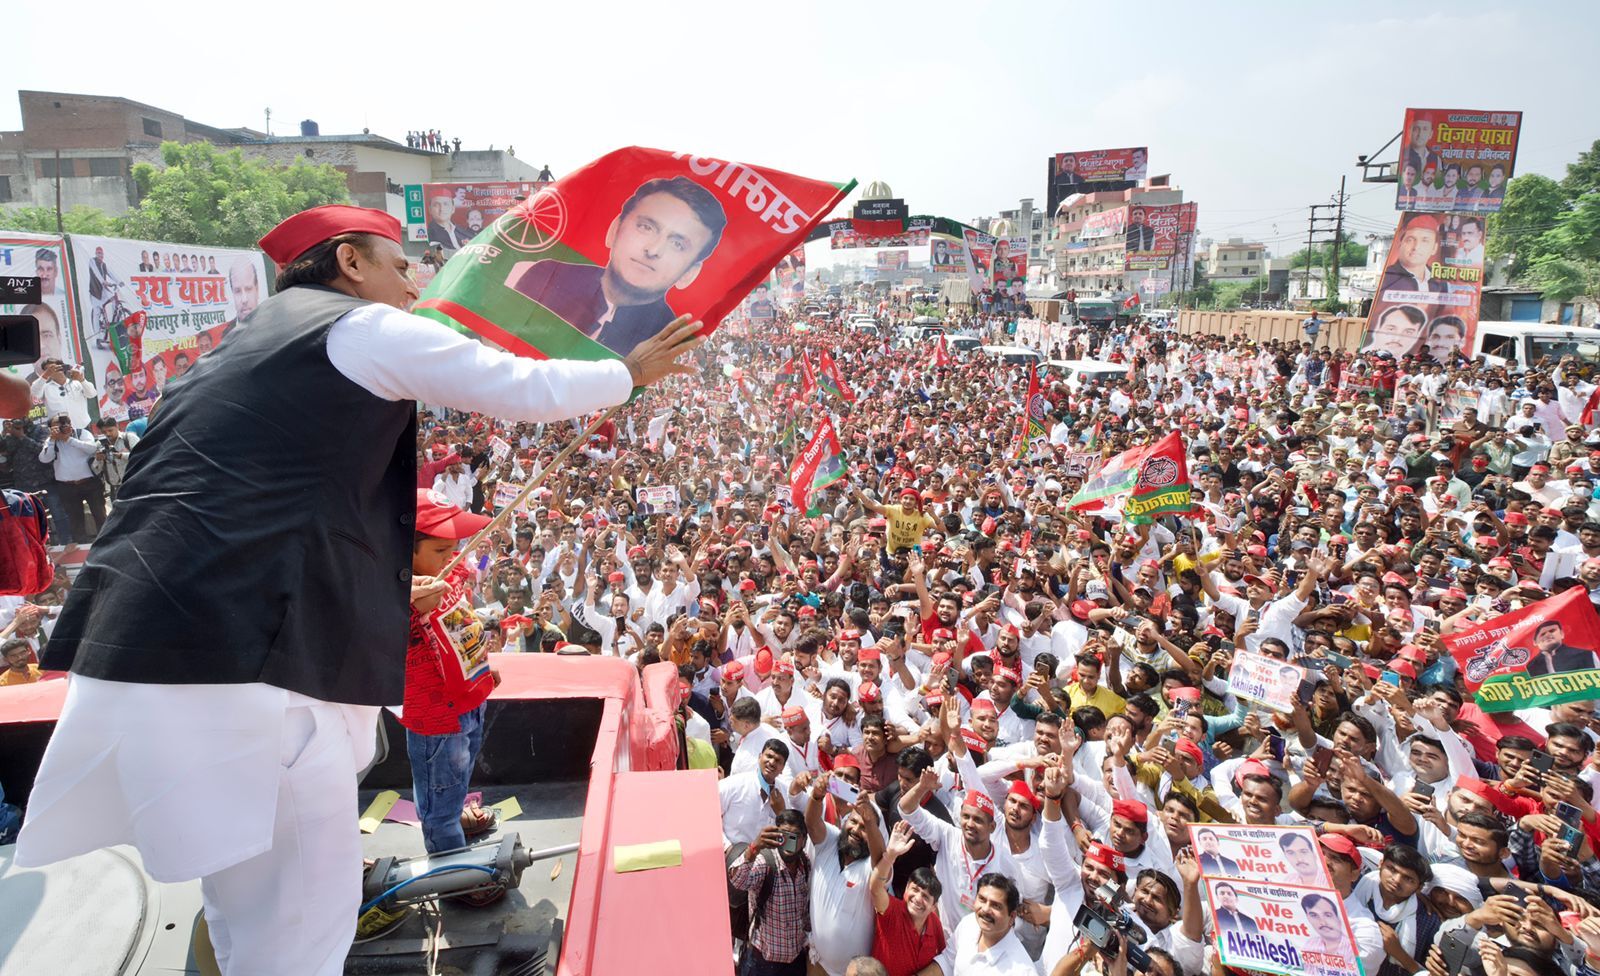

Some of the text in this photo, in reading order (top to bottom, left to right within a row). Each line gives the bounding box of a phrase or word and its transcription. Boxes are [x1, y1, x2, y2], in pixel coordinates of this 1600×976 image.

[1437, 123, 1514, 145] विजय यात्रा
[1431, 262, 1480, 281] विजय यात्रा
[7, 278, 34, 287] ANI
[176, 277, 227, 304] यात्रा
[181, 309, 190, 327] में
[1255, 664, 1273, 675] We
[1231, 676, 1265, 698] Akhilesh
[1250, 671, 1277, 686] Want
[1241, 844, 1272, 858] We
[1236, 858, 1288, 874] Want
[1260, 902, 1293, 919] We
[1255, 916, 1310, 937] Want
[1227, 930, 1300, 967] Akhilesh
[1323, 953, 1346, 969] यादव
